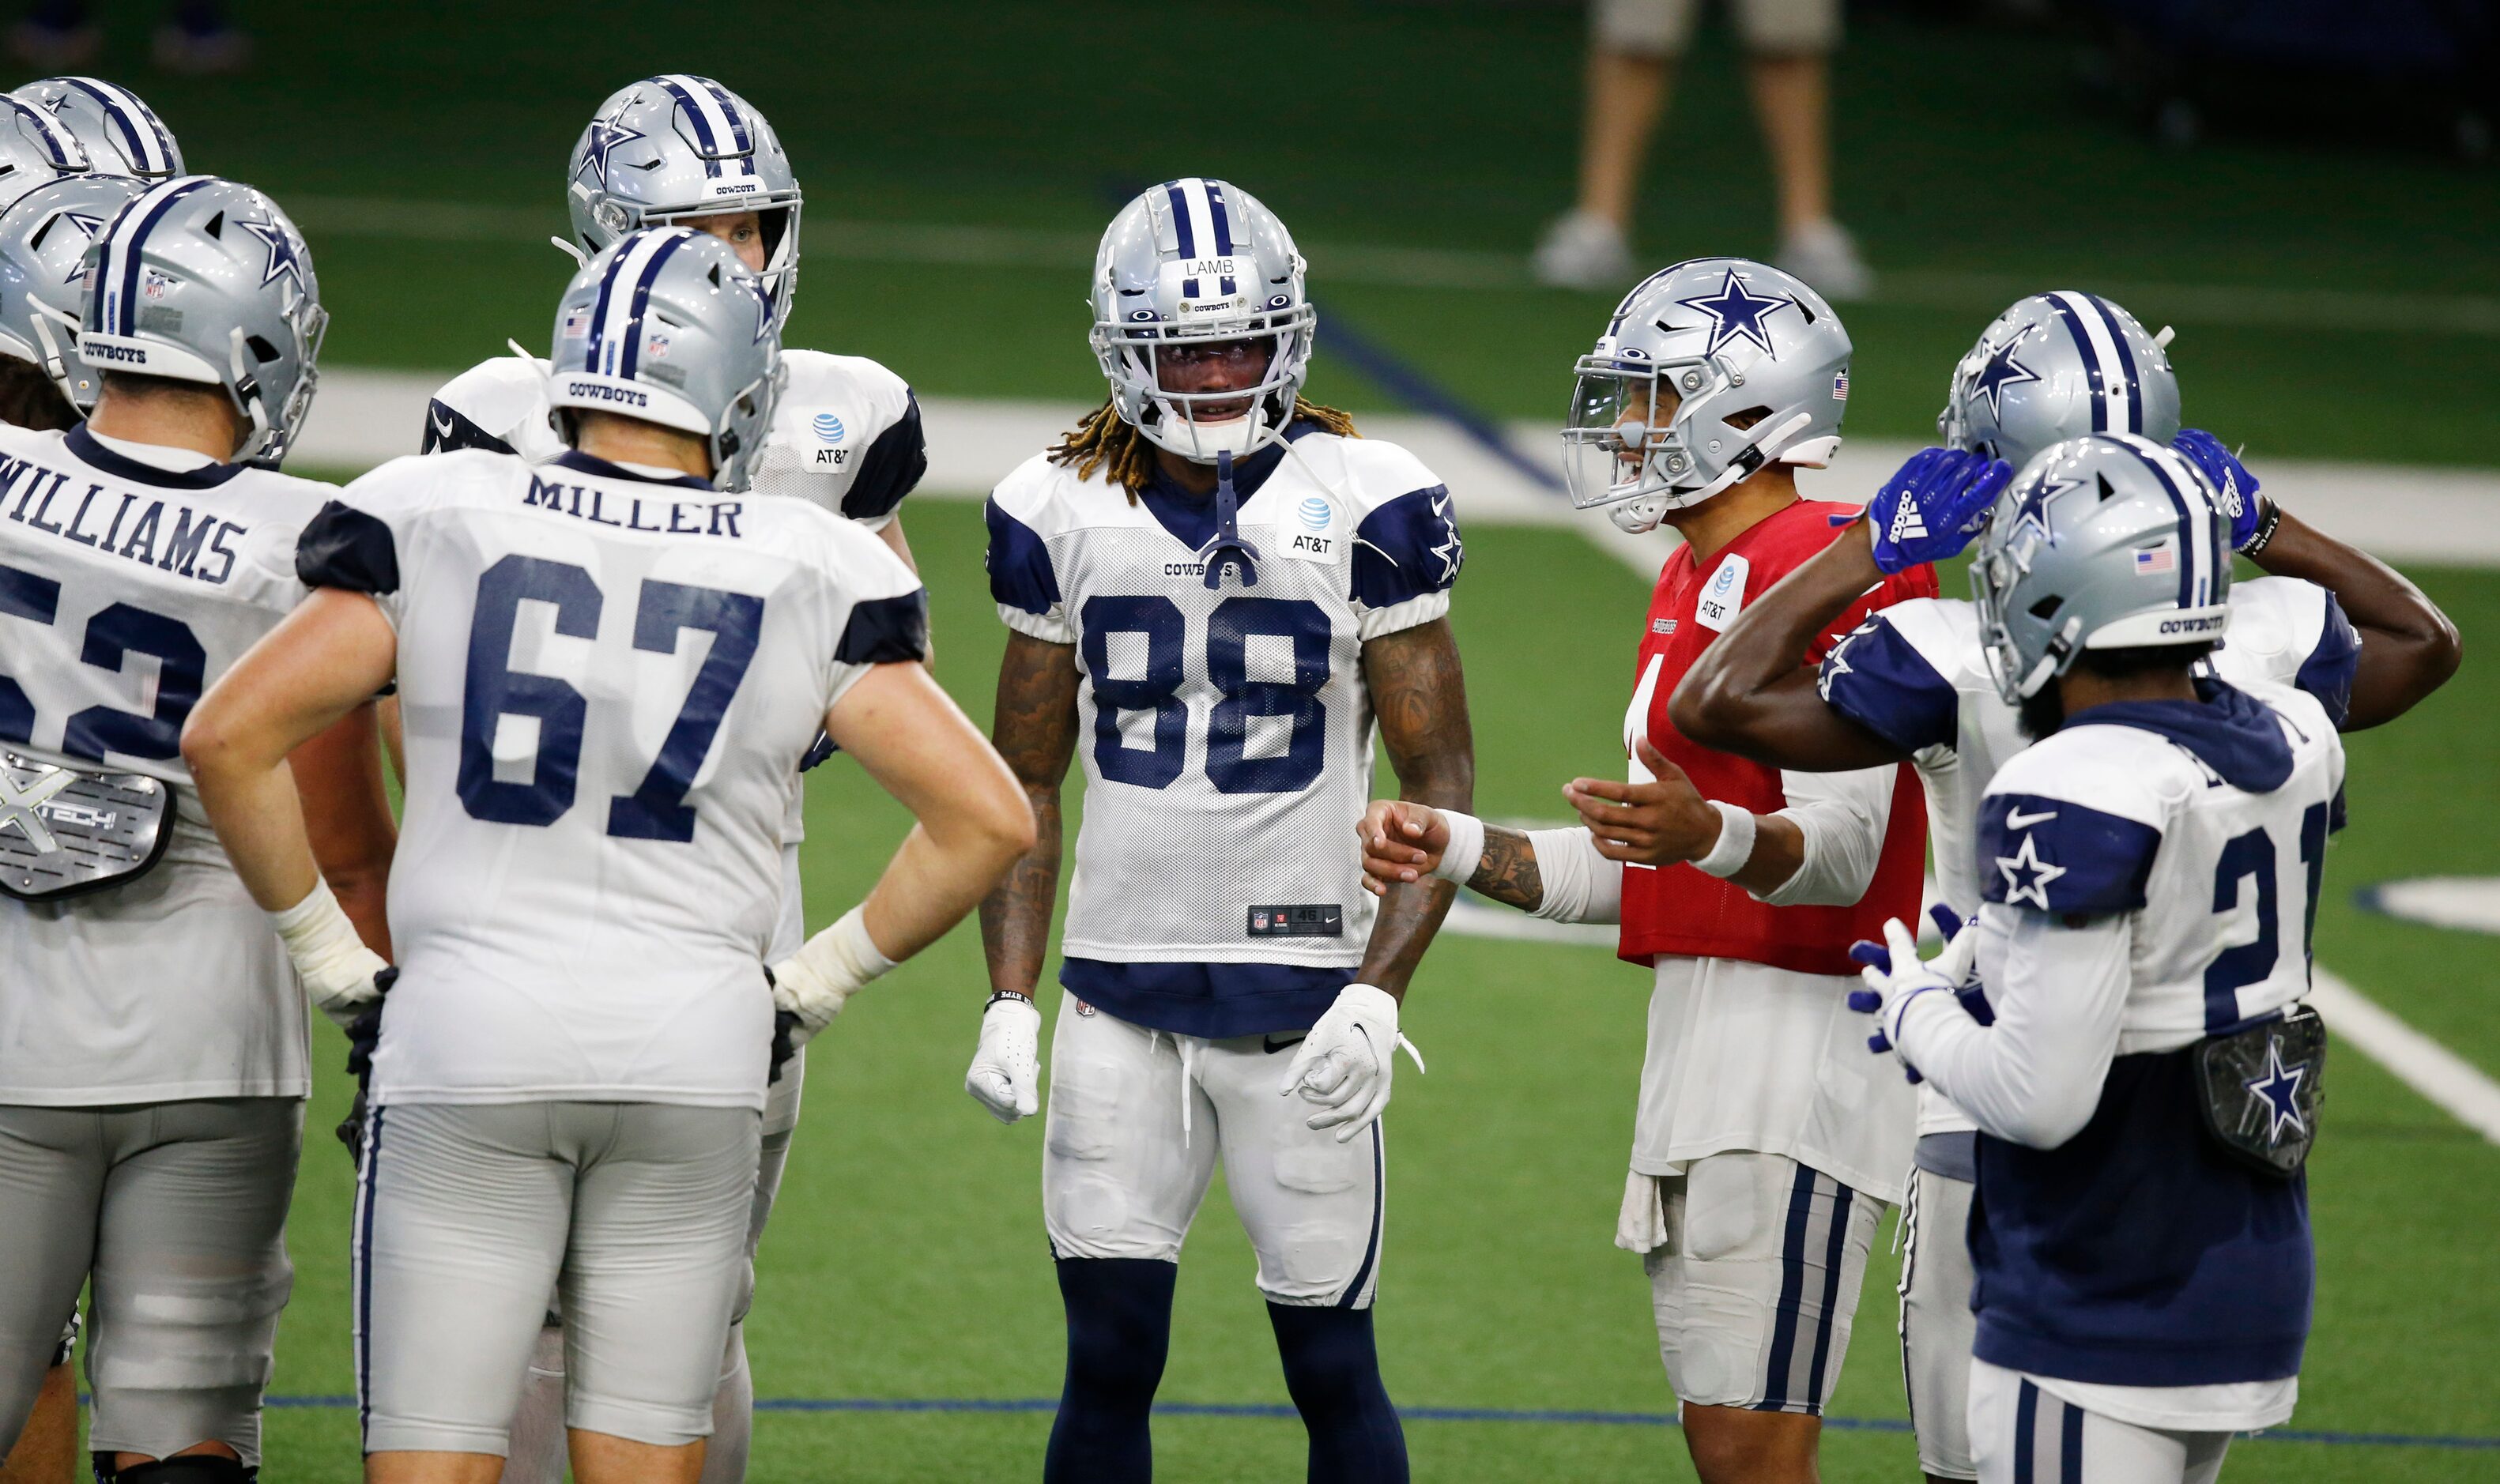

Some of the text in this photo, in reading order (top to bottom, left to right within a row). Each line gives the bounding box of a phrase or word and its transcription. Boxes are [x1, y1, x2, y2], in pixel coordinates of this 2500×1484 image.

[716, 184, 756, 194] COWBOYS
[1186, 259, 1235, 277] LAMB
[1194, 302, 1230, 312] COWBOYS
[84, 341, 146, 363] COWBOYS
[570, 382, 647, 407] COWBOYS
[816, 450, 848, 464] AT&T
[2224, 465, 2243, 518] adidas
[523, 473, 742, 537] MILLER
[1889, 490, 1912, 544] adidas
[1293, 536, 1331, 553] AT&T
[1164, 563, 1233, 577] COWBS
[1701, 600, 1726, 620] AT&T
[456, 553, 765, 842] 67
[1080, 595, 1332, 794] 88
[1298, 910, 1317, 921] 46
[2204, 800, 2328, 1029] 21
[1001, 991, 1022, 1001] HYPE
[1077, 999, 1095, 1015] NFL
